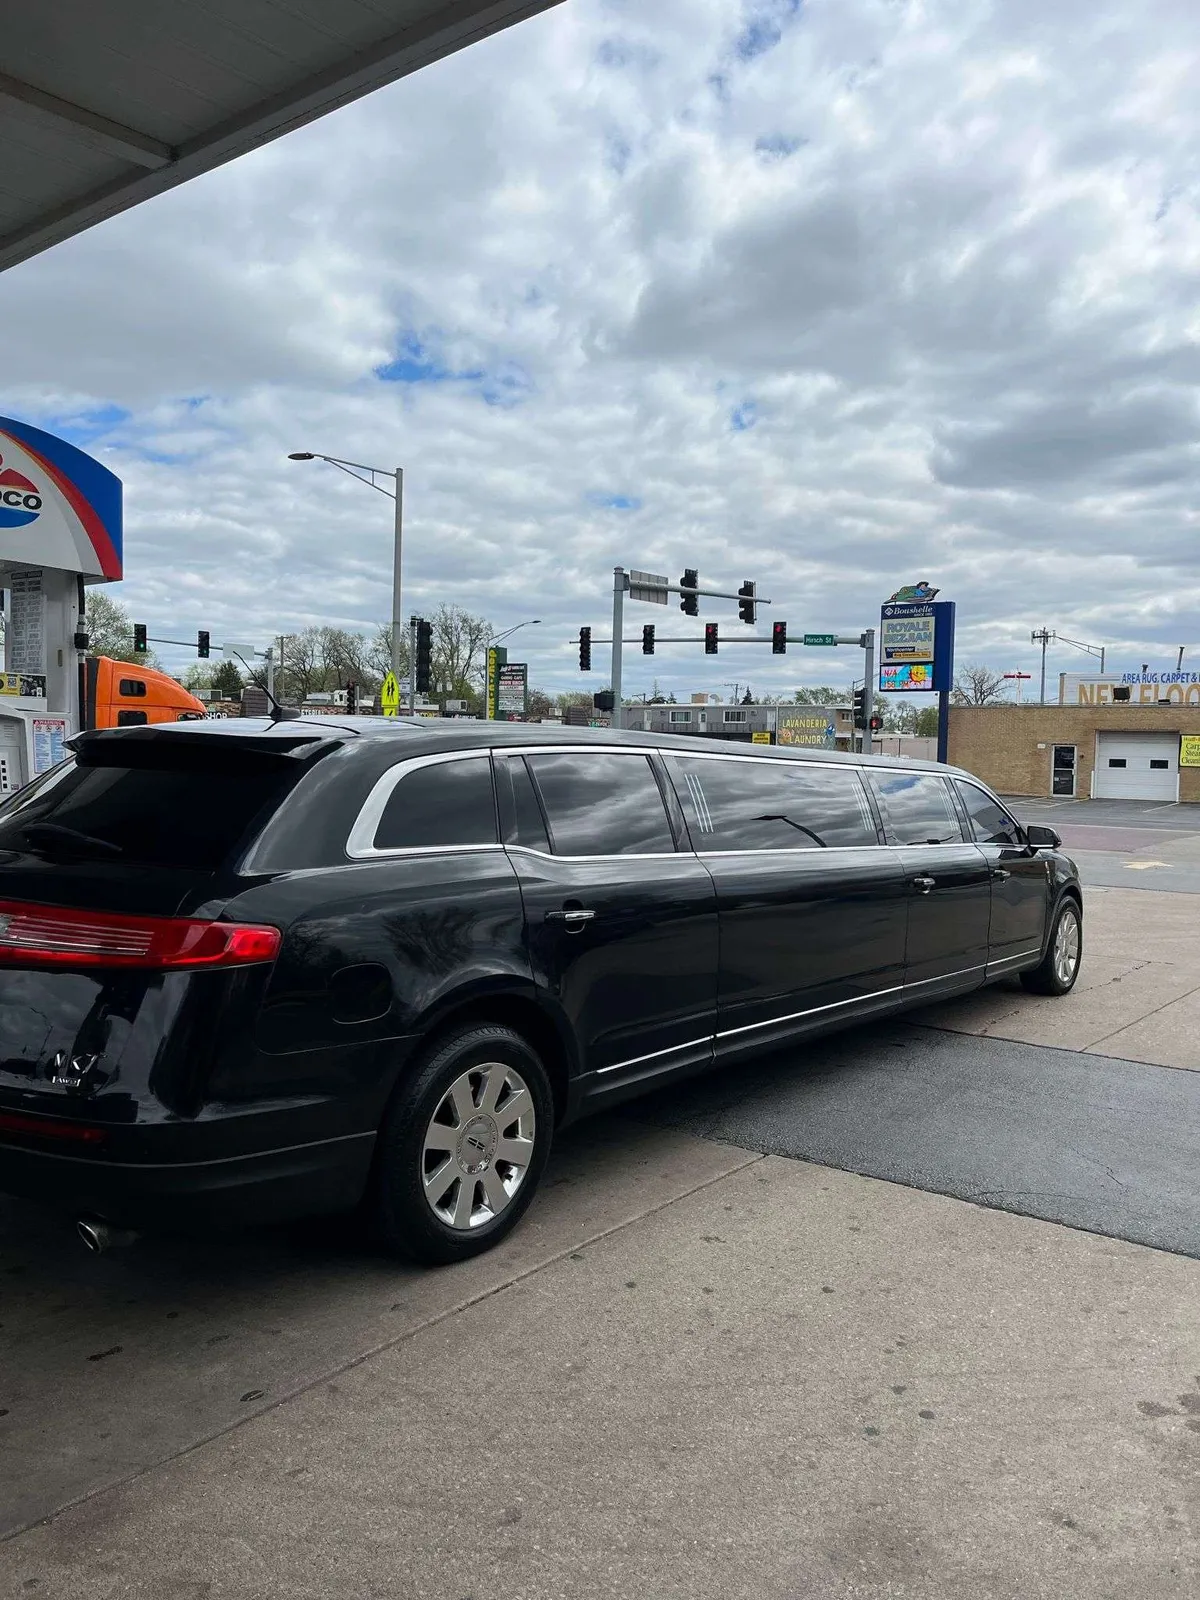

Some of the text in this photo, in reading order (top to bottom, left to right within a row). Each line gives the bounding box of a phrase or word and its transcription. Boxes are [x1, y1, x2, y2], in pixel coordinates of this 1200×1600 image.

[806, 636, 832, 644] Hirsch St
[1122, 673, 1141, 683] AREA
[1161, 672, 1190, 683] CARPET
[1191, 672, 1198, 683] &
[782, 719, 828, 728] LAVANDERIA
[790, 735, 827, 744] LAUNDRY
